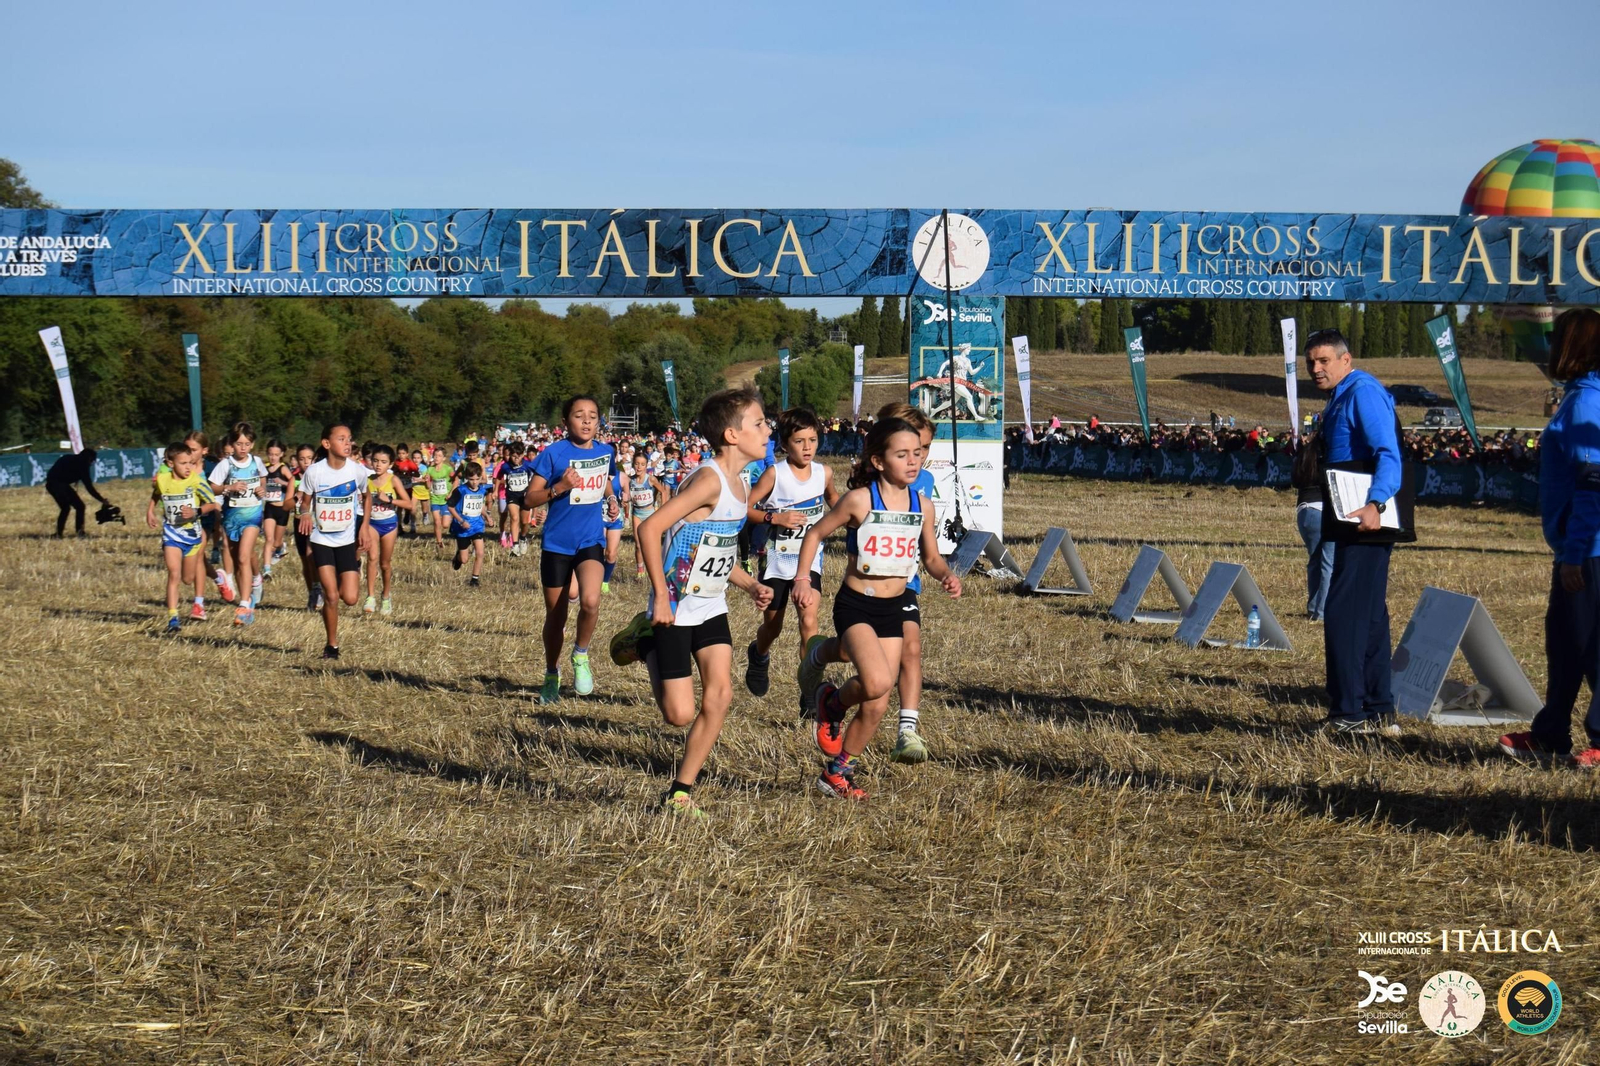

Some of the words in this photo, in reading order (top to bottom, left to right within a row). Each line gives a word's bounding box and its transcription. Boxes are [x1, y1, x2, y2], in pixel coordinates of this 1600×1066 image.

[0, 236, 18, 249] DE
[20, 233, 112, 249] ANDALUCÍA
[172, 222, 332, 274] XLIII
[335, 222, 459, 253] CROSS
[515, 208, 818, 279] ITÁLICA
[1033, 222, 1193, 275] XLIII
[1197, 225, 1321, 257] CROSS
[5, 250, 17, 263] A
[19, 247, 78, 263] TRAVÉS
[335, 256, 504, 273] INTERNACIONAL
[1197, 259, 1366, 278] INTERNACIONAL
[172, 278, 323, 294] INTERNATIONAL
[326, 277, 383, 293] CROSS
[386, 277, 475, 293] COUNTRY
[1032, 278, 1183, 295] INTERNATIONAL
[1186, 279, 1243, 295] CROSS
[1247, 280, 1336, 297] COUNTRY
[958, 312, 992, 323] Sevilla
[318, 509, 352, 522] 4418
[863, 535, 916, 559] 4356
